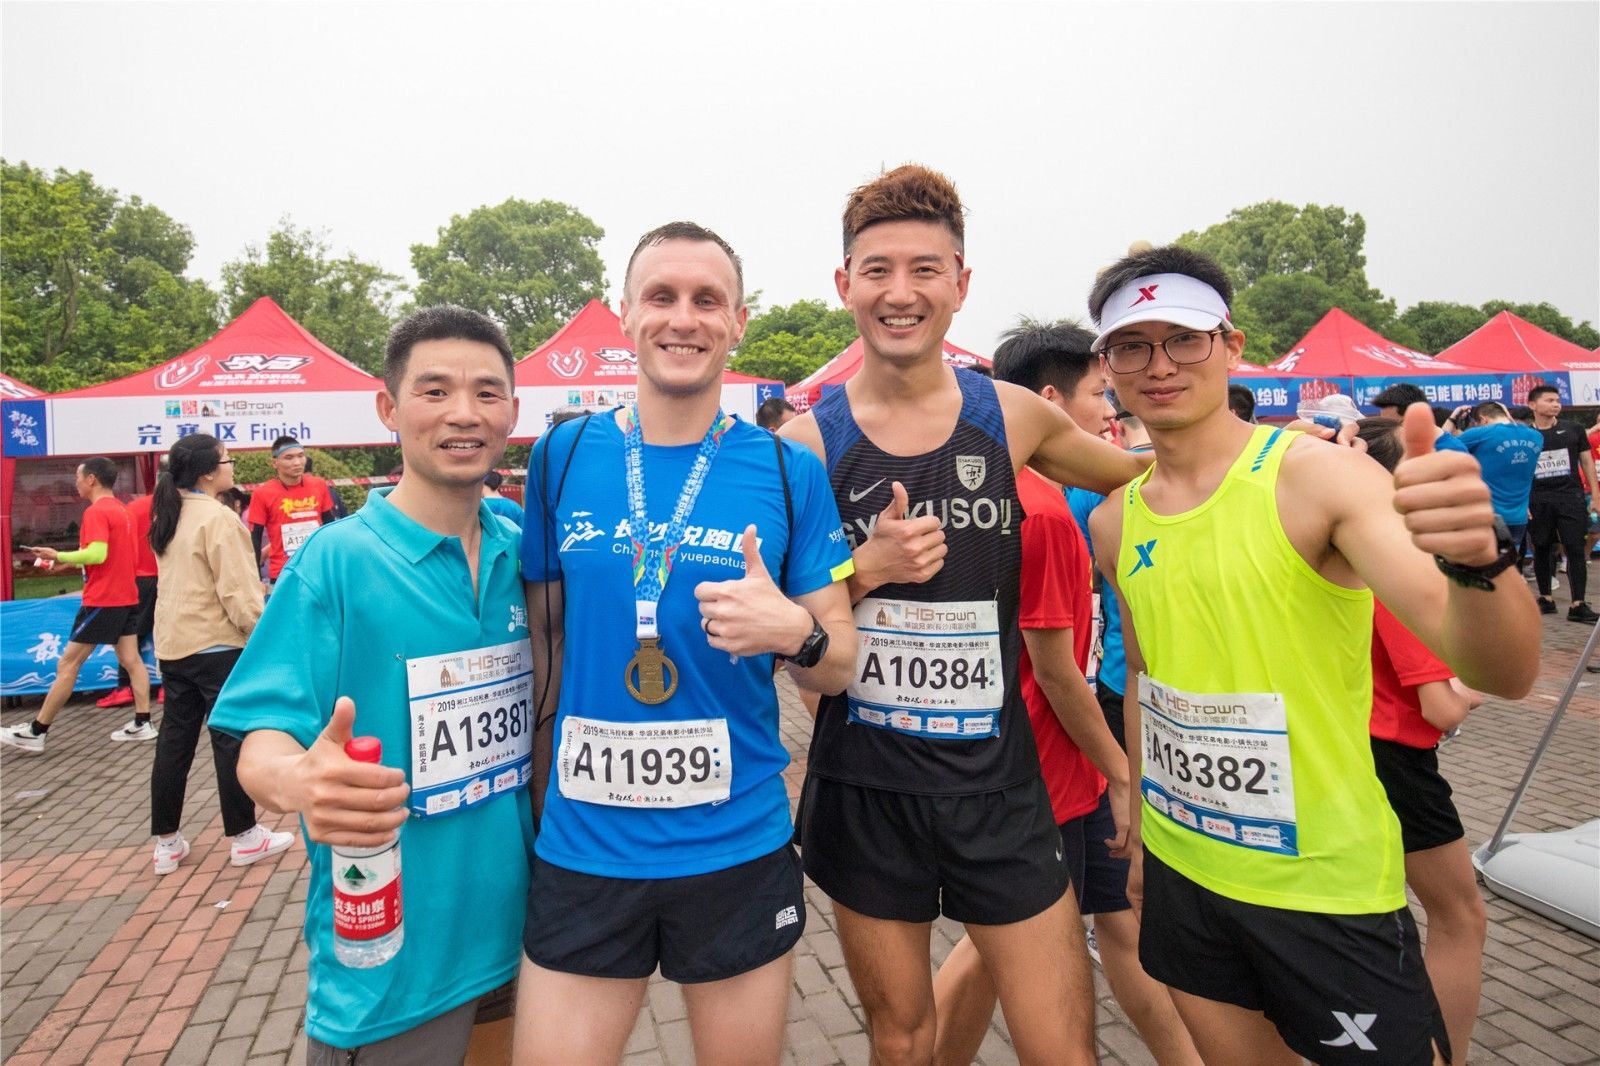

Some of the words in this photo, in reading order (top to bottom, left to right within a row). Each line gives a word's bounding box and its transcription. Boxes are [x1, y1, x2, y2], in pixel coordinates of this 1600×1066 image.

[1251, 388, 1288, 406] 给站
[251, 422, 311, 441] Finish
[842, 497, 1012, 551] GYKUSOU
[680, 552, 747, 570] yuepaotua
[860, 652, 988, 690] A10384
[430, 699, 528, 762] A13387
[573, 742, 711, 786] A11939
[1153, 731, 1269, 795] A13382
[335, 896, 385, 916] 农夫山泉
